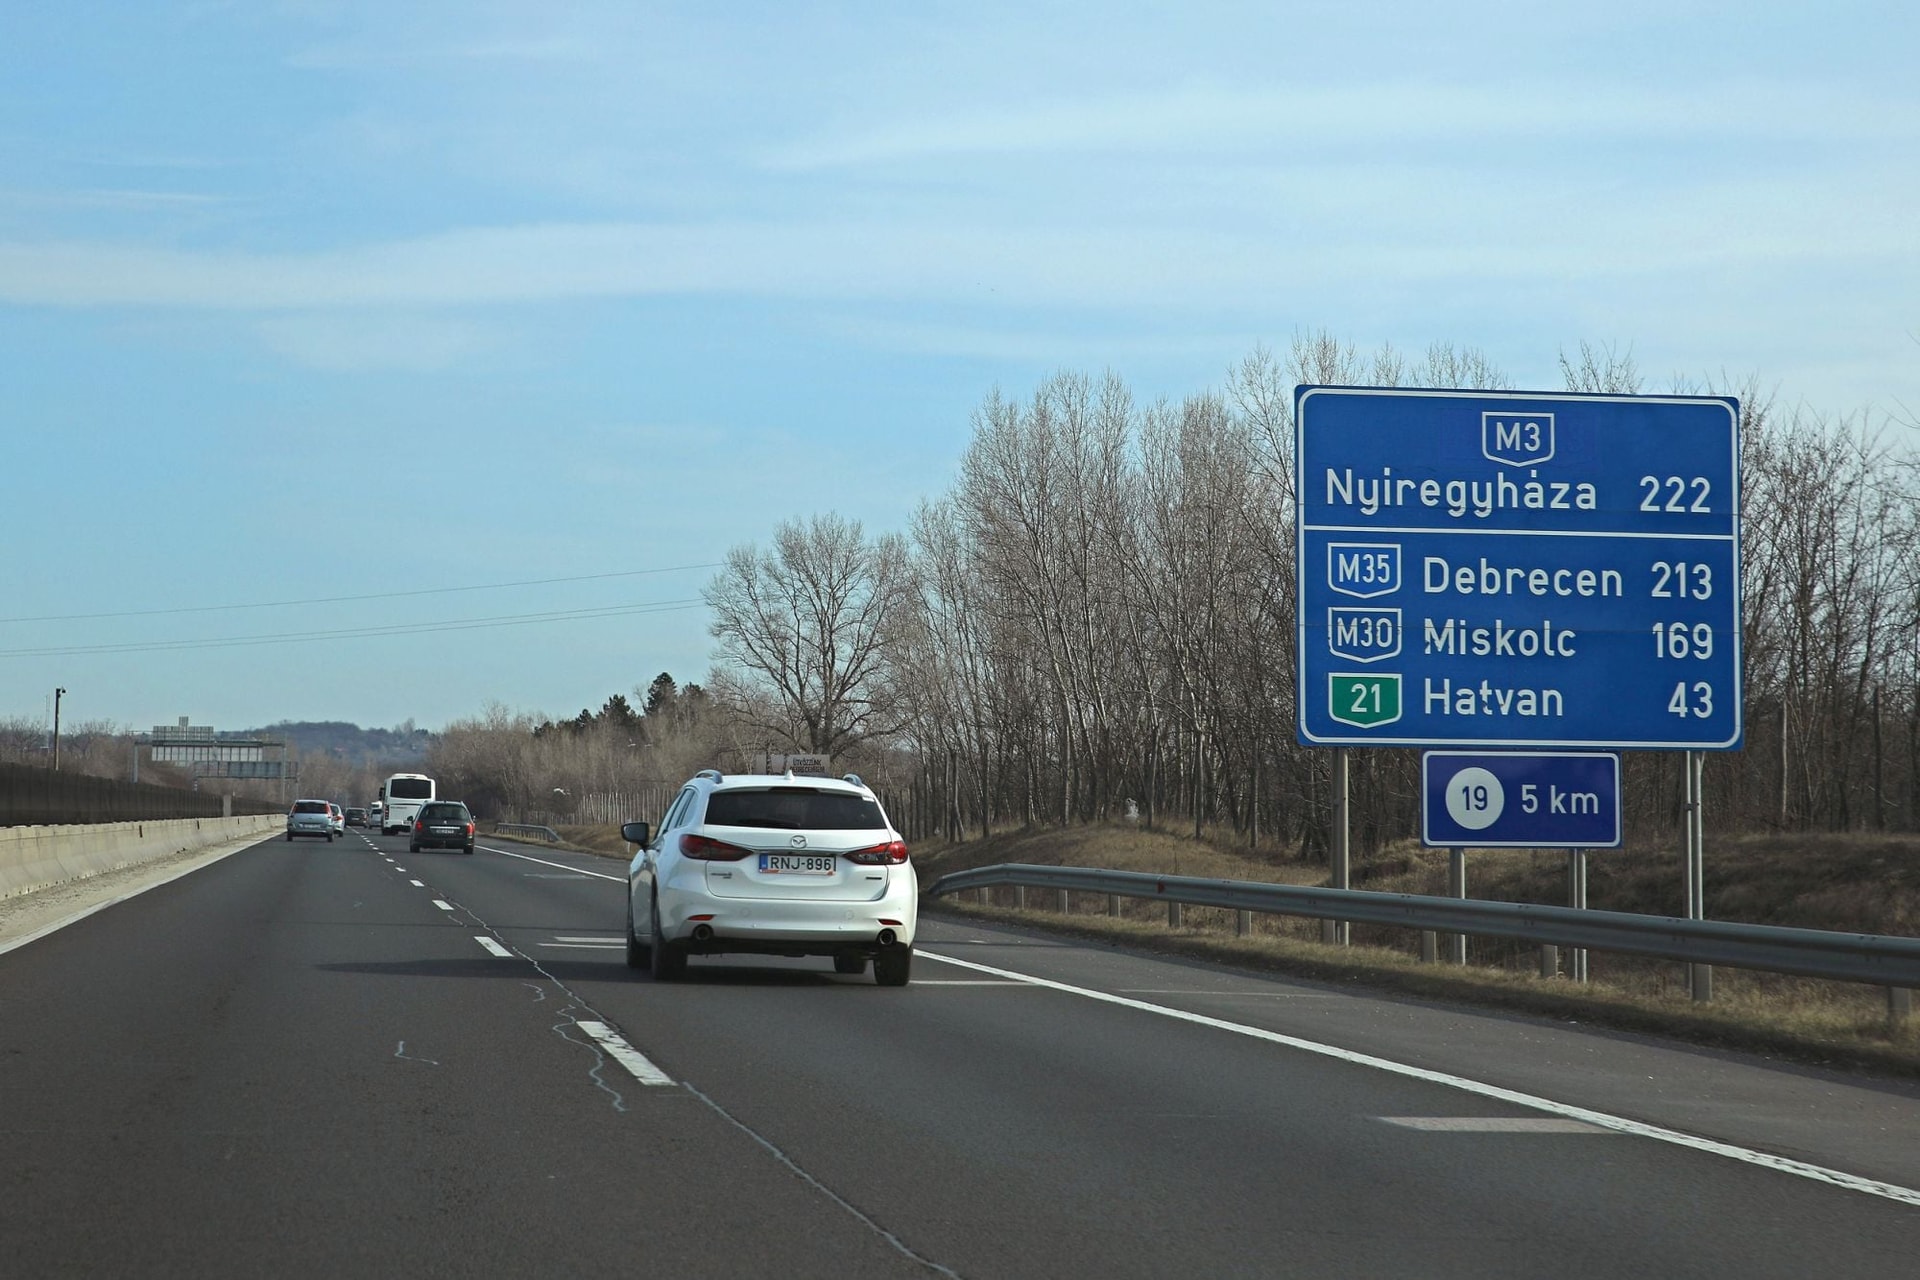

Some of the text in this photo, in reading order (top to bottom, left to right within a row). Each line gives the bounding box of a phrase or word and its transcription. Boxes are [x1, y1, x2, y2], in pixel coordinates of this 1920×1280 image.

[1496, 422, 1541, 452] M3
[1640, 475, 1711, 513] 222
[1338, 553, 1712, 600] M35 Debrecen 213
[1336, 617, 1713, 660] M30 Miskolc 169
[1350, 678, 1713, 718] 21 Hatvan 43
[1461, 784, 1599, 814] 19 5 km
[770, 856, 832, 871] RNJ-896
